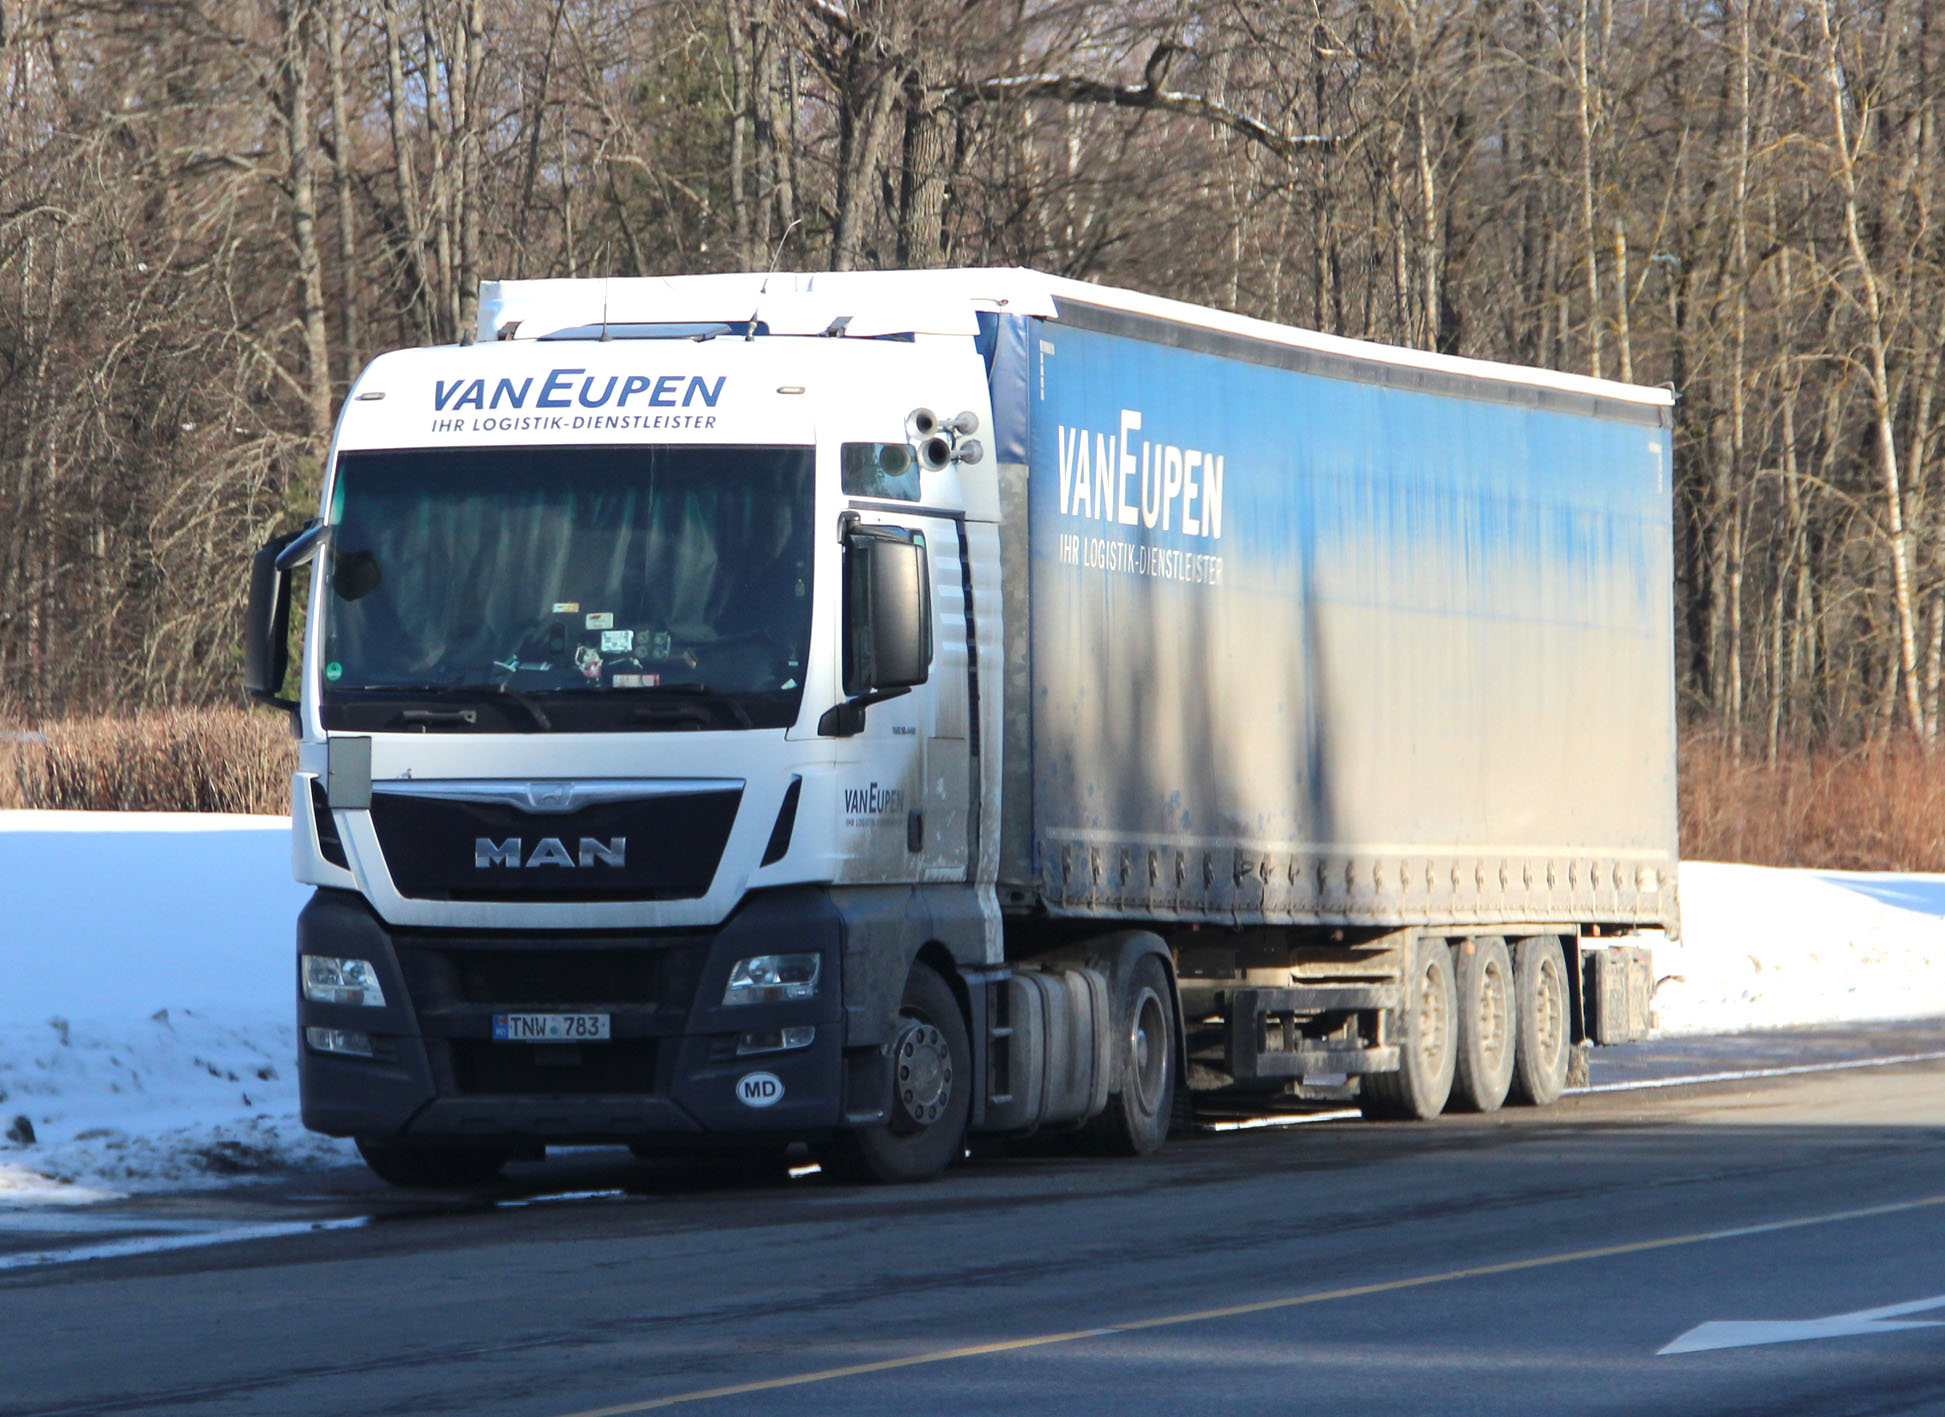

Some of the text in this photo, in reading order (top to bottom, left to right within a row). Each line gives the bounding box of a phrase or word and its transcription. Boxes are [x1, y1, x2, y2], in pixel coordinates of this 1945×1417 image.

[431, 415, 717, 433] IHR LOGISTIK-DIENSTLEISTER
[1060, 533, 1224, 585] IHR LOGISTIK-DIENSTLEISTER
[475, 837, 626, 868] MAN
[563, 1017, 599, 1036] 783
[744, 1081, 776, 1098] MD
